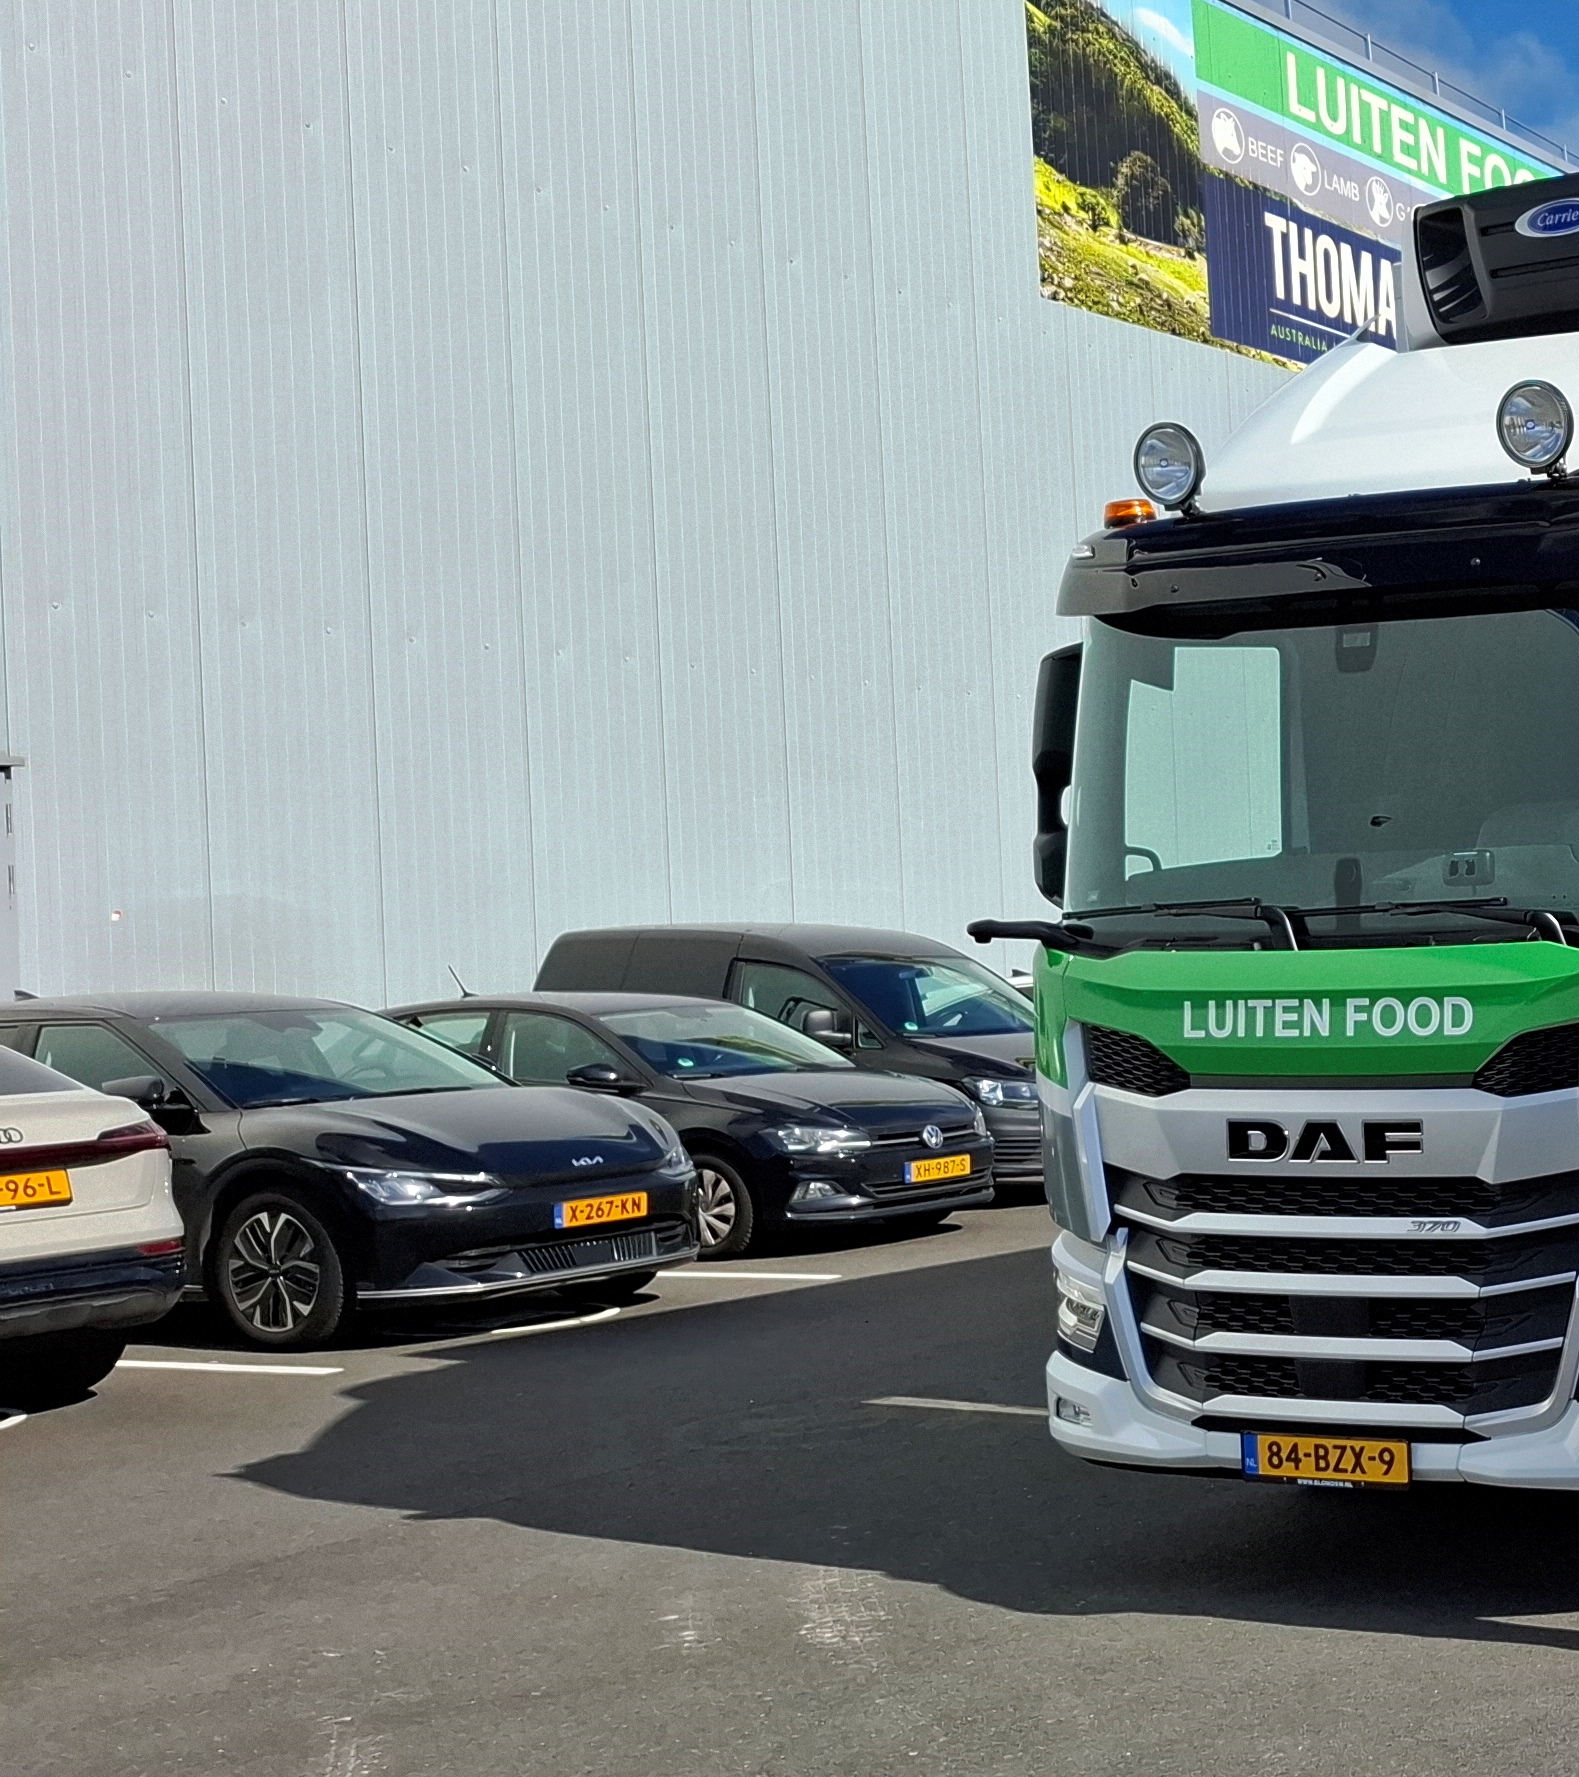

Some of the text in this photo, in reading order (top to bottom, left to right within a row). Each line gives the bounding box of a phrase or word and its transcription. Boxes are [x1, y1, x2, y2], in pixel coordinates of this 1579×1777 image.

[1286, 51, 1447, 184] LUITEN
[1248, 137, 1284, 167] BEEF
[1324, 170, 1360, 200] LAMB
[1271, 324, 1329, 351] AUSTRALIA
[1183, 996, 1474, 1038] LUITEN FOOD
[1226, 1118, 1425, 1164] DAF
[915, 1158, 966, 1179] XH-987-S
[569, 1196, 642, 1223] X-267-KN
[1407, 1220, 1461, 1232] 370
[1267, 1440, 1396, 1476] 84-BZX-9
